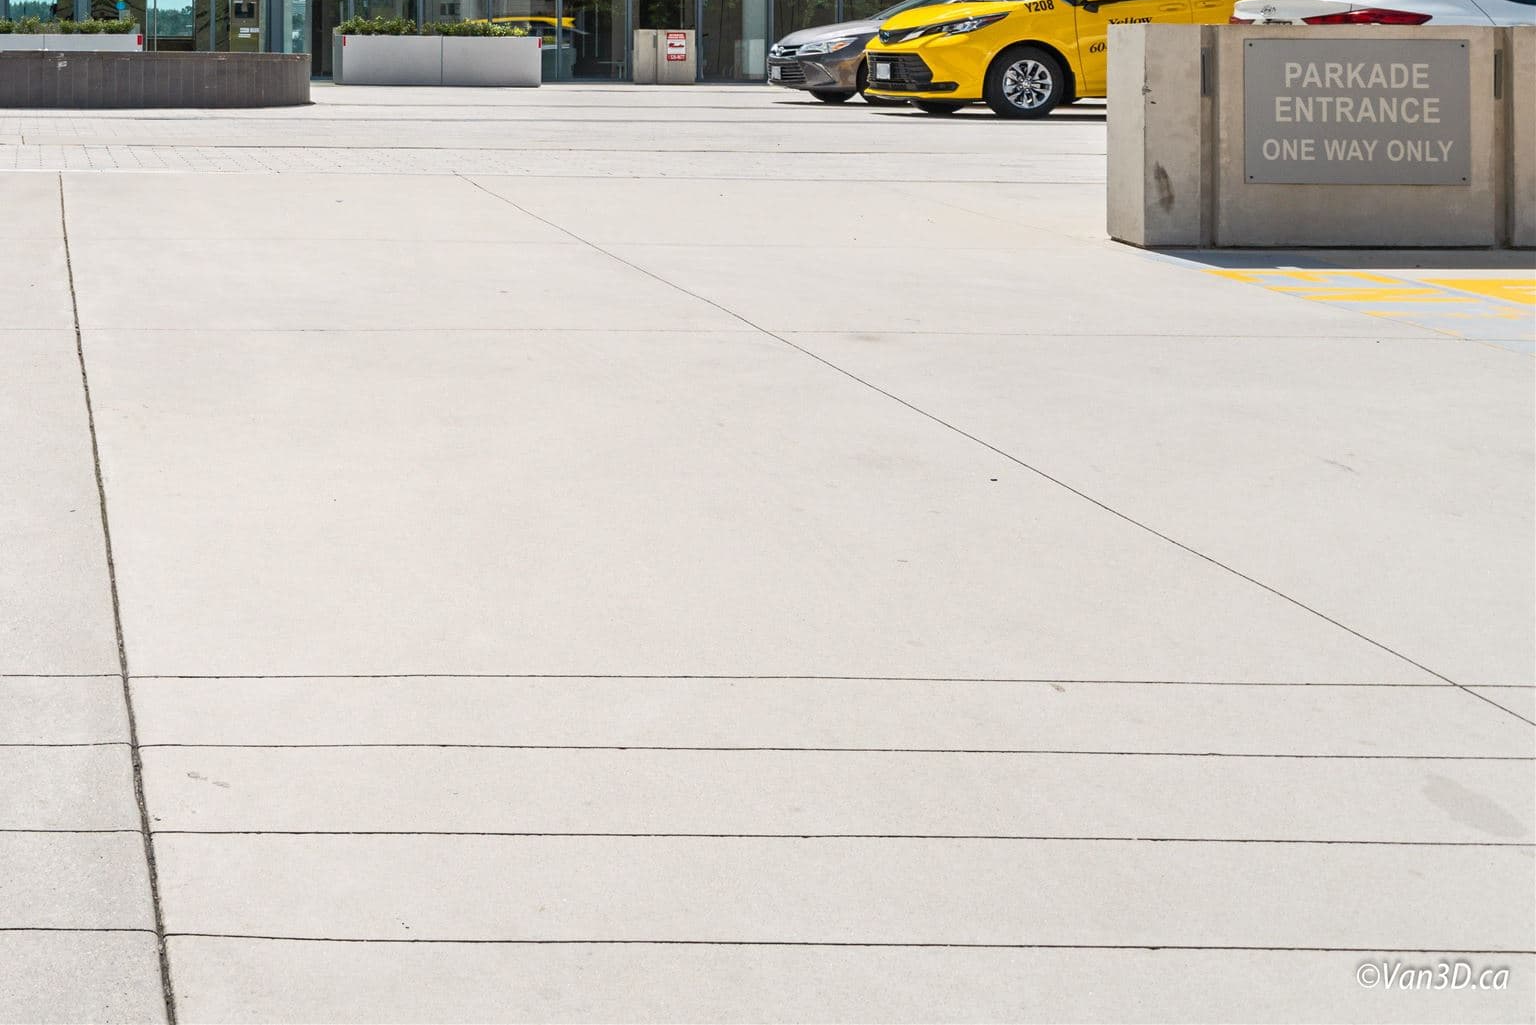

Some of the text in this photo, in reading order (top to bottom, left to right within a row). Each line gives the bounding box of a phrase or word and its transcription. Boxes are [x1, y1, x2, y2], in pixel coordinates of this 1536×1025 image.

[1024, 0, 1055, 13] Y208
[1089, 42, 1107, 53] 60
[1285, 63, 1430, 89] PARKADE
[1275, 97, 1441, 124] ENTRANCE
[1262, 139, 1454, 162] ONE WAY ONLY
